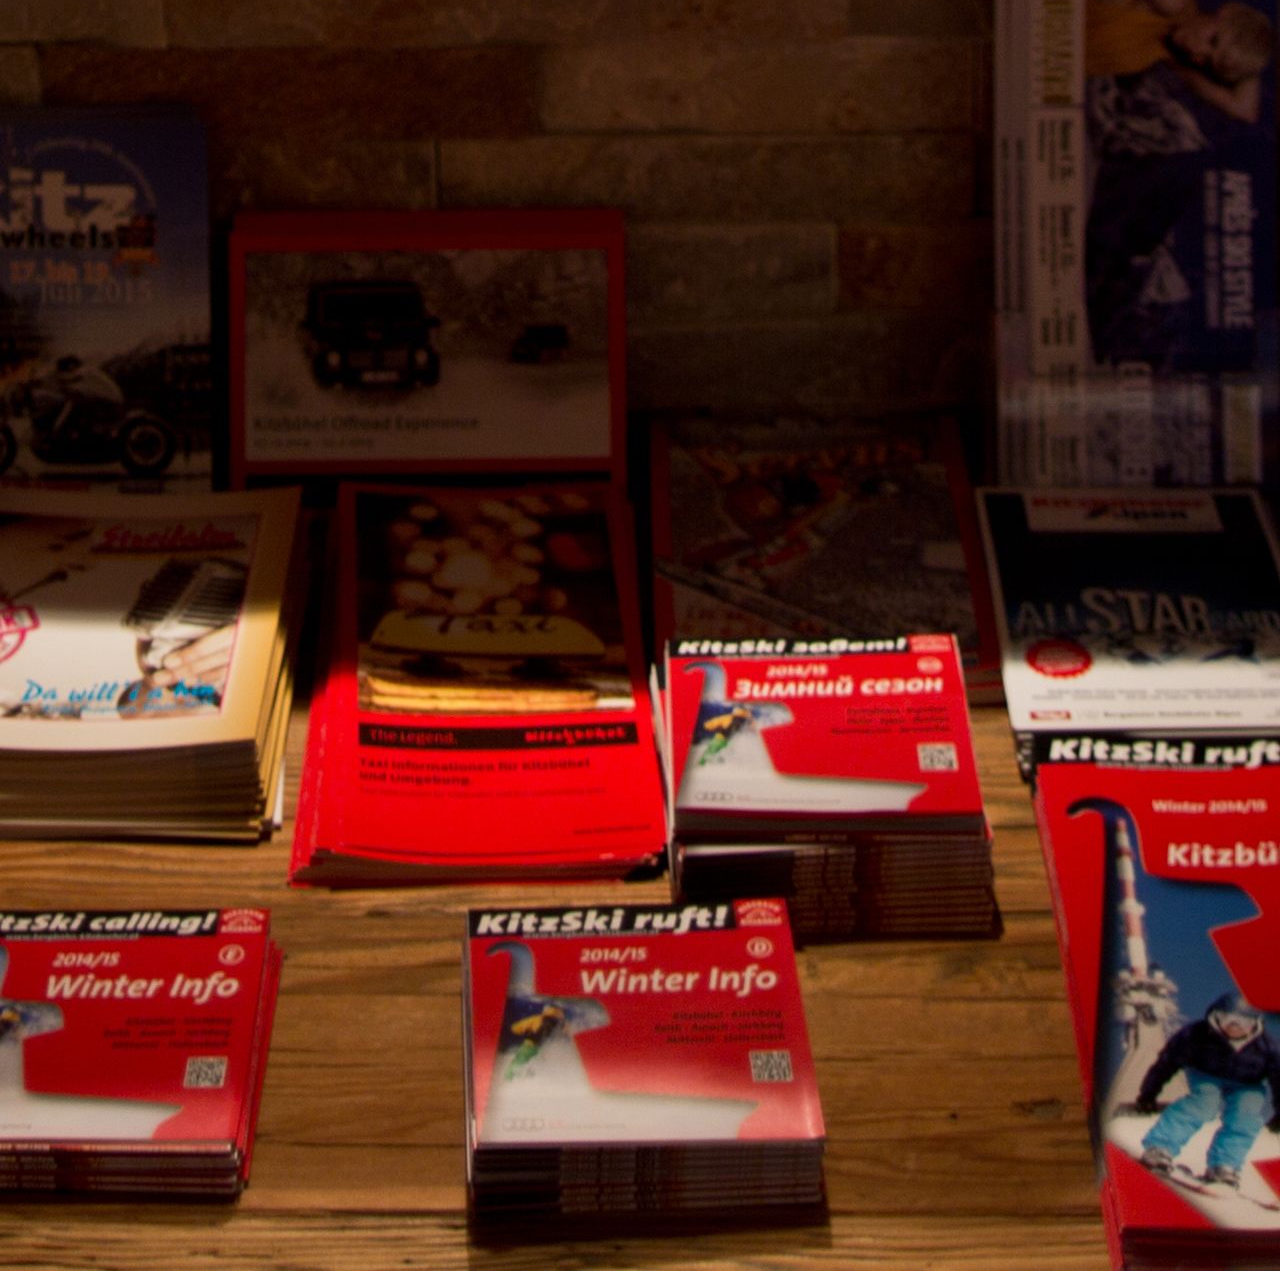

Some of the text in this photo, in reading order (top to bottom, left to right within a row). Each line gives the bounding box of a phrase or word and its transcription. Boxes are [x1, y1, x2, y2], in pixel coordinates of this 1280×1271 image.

[1, 224, 113, 248] wheels
[1077, 584, 1212, 636] STAR
[676, 638, 784, 657] KitzSki
[68, 682, 118, 703] will
[732, 674, 945, 701] Зимний сезон
[1047, 735, 1197, 764] KitzSki
[1151, 798, 1205, 816] Winter
[87, 910, 218, 936] calling!
[475, 904, 731, 936] KitzSki ruft!
[51, 951, 122, 968] 2014/15
[578, 945, 649, 963] 2014/15
[44, 973, 241, 1006] Winter Info
[578, 963, 779, 998] Winter Info
